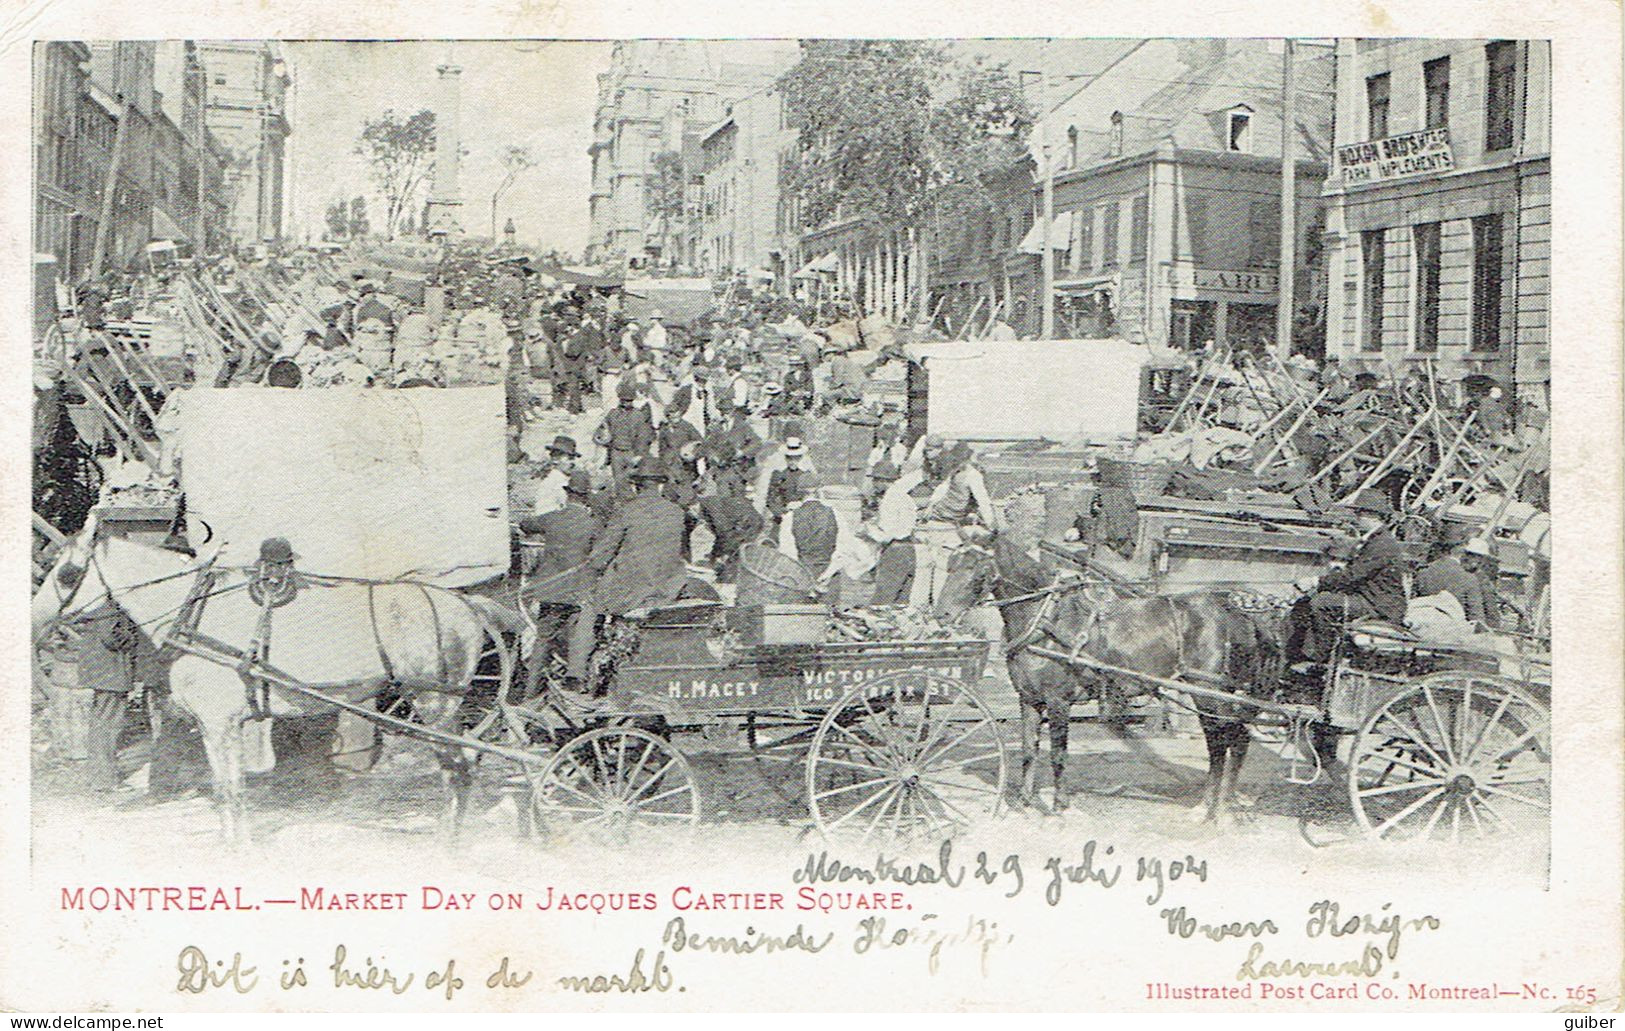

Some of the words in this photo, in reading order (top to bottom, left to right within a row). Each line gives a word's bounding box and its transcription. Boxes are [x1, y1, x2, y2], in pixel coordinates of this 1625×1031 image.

[794, 839, 967, 889] Montreal
[974, 851, 1025, 899] 29
[1136, 854, 1209, 907] 1904
[177, 945, 260, 995] Dit
[280, 956, 308, 991] is
[1146, 982, 1254, 1002] Illustrated
[1260, 982, 1306, 1002] Post
[1310, 982, 1360, 1002] Card
[1366, 983, 1401, 1002] Co.
[1566, 985, 1598, 1005] 165
